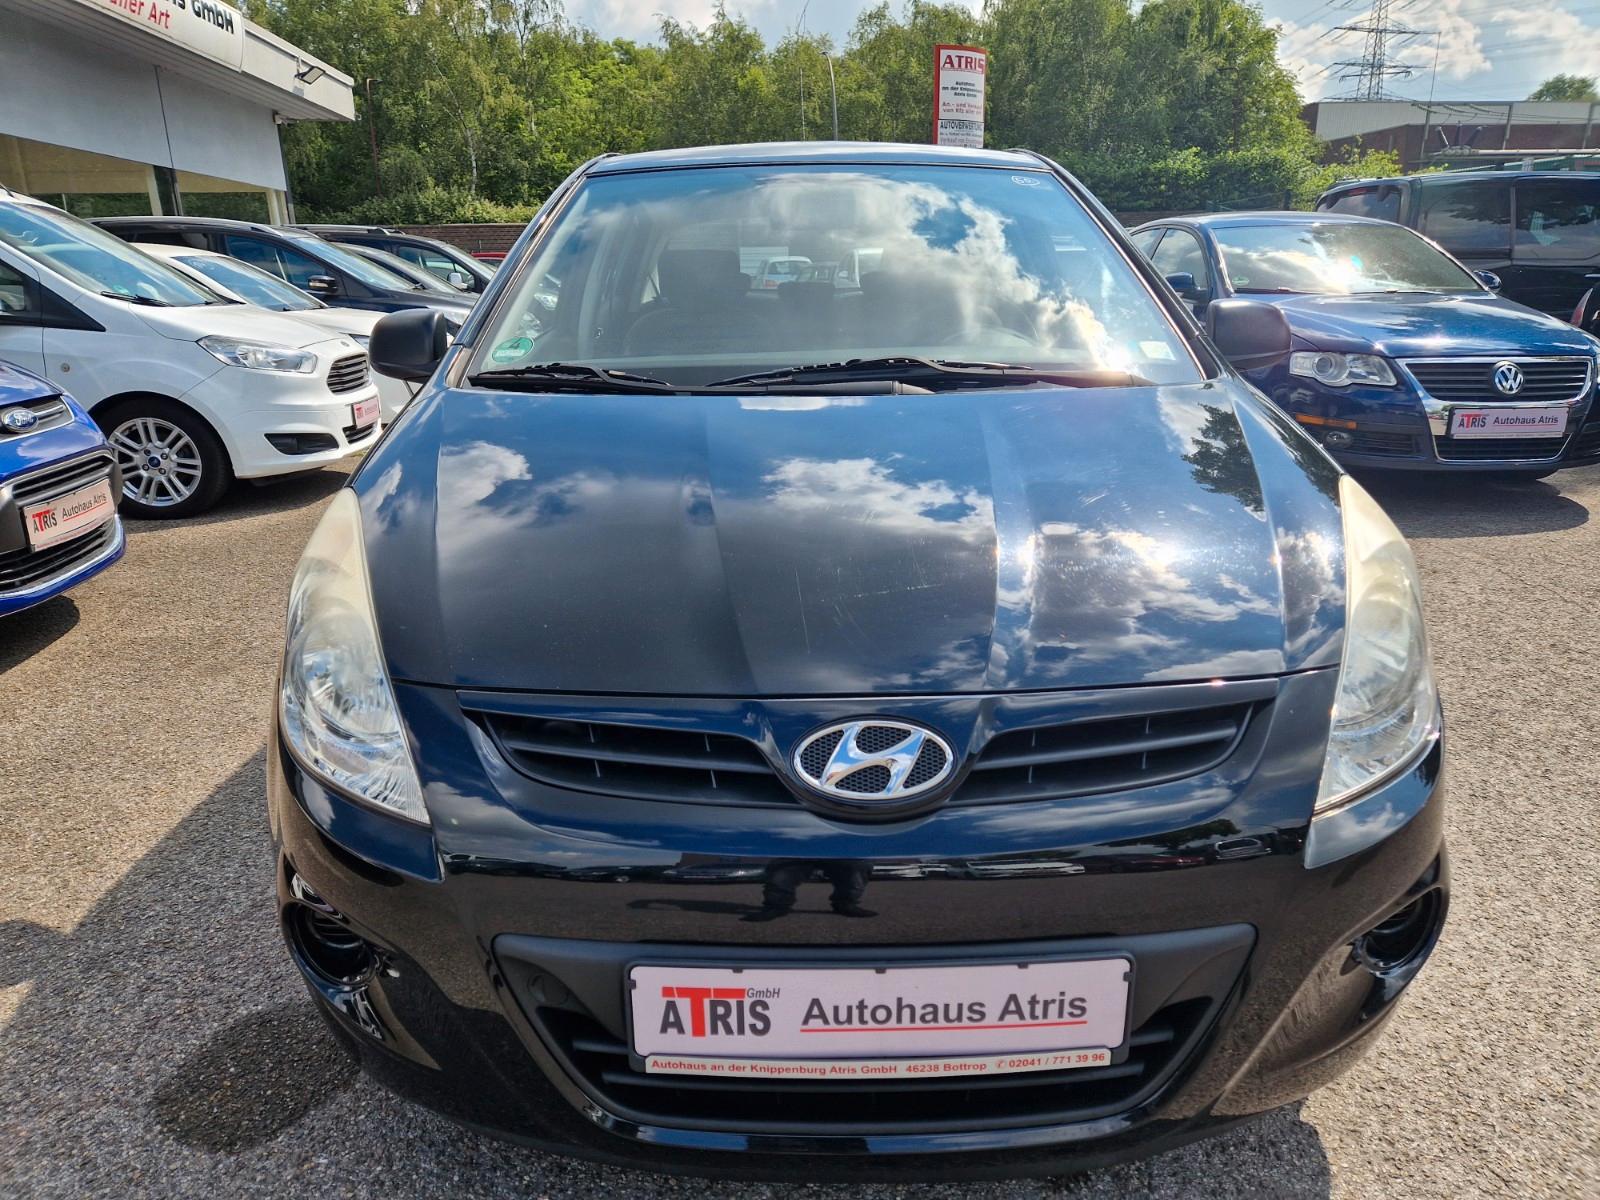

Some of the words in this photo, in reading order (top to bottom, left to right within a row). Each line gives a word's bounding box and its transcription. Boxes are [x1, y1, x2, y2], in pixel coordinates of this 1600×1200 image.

[110, 0, 145, 15] ler
[148, 2, 170, 29] Art
[192, 0, 234, 34] GmbH
[942, 54, 985, 75] ATRIS
[1458, 412, 1487, 429] ATRIS
[1493, 416, 1536, 425] Autohaus
[1538, 415, 1559, 424] Atris
[32, 507, 58, 532] ATRIS
[62, 501, 93, 519] Autohaus
[746, 987, 781, 999] GmbH
[659, 986, 772, 1038] ATRIS
[801, 997, 987, 1026] Autohaus
[997, 991, 1088, 1022] Atris
[651, 1059, 707, 1071] Autohaus
[710, 1063, 724, 1072] an
[727, 1062, 747, 1073] der
[750, 1064, 826, 1076] Knippenburg
[830, 1064, 857, 1075] Atris
[860, 1065, 898, 1075] GmbH
[905, 1064, 940, 1073] 46238
[943, 1061, 987, 1073] Bottrop
[1008, 1057, 1042, 1069] 02041
[1052, 1054, 1072, 1066] 771
[1075, 1053, 1089, 1063] 39
[1091, 1052, 1105, 1063] 96
